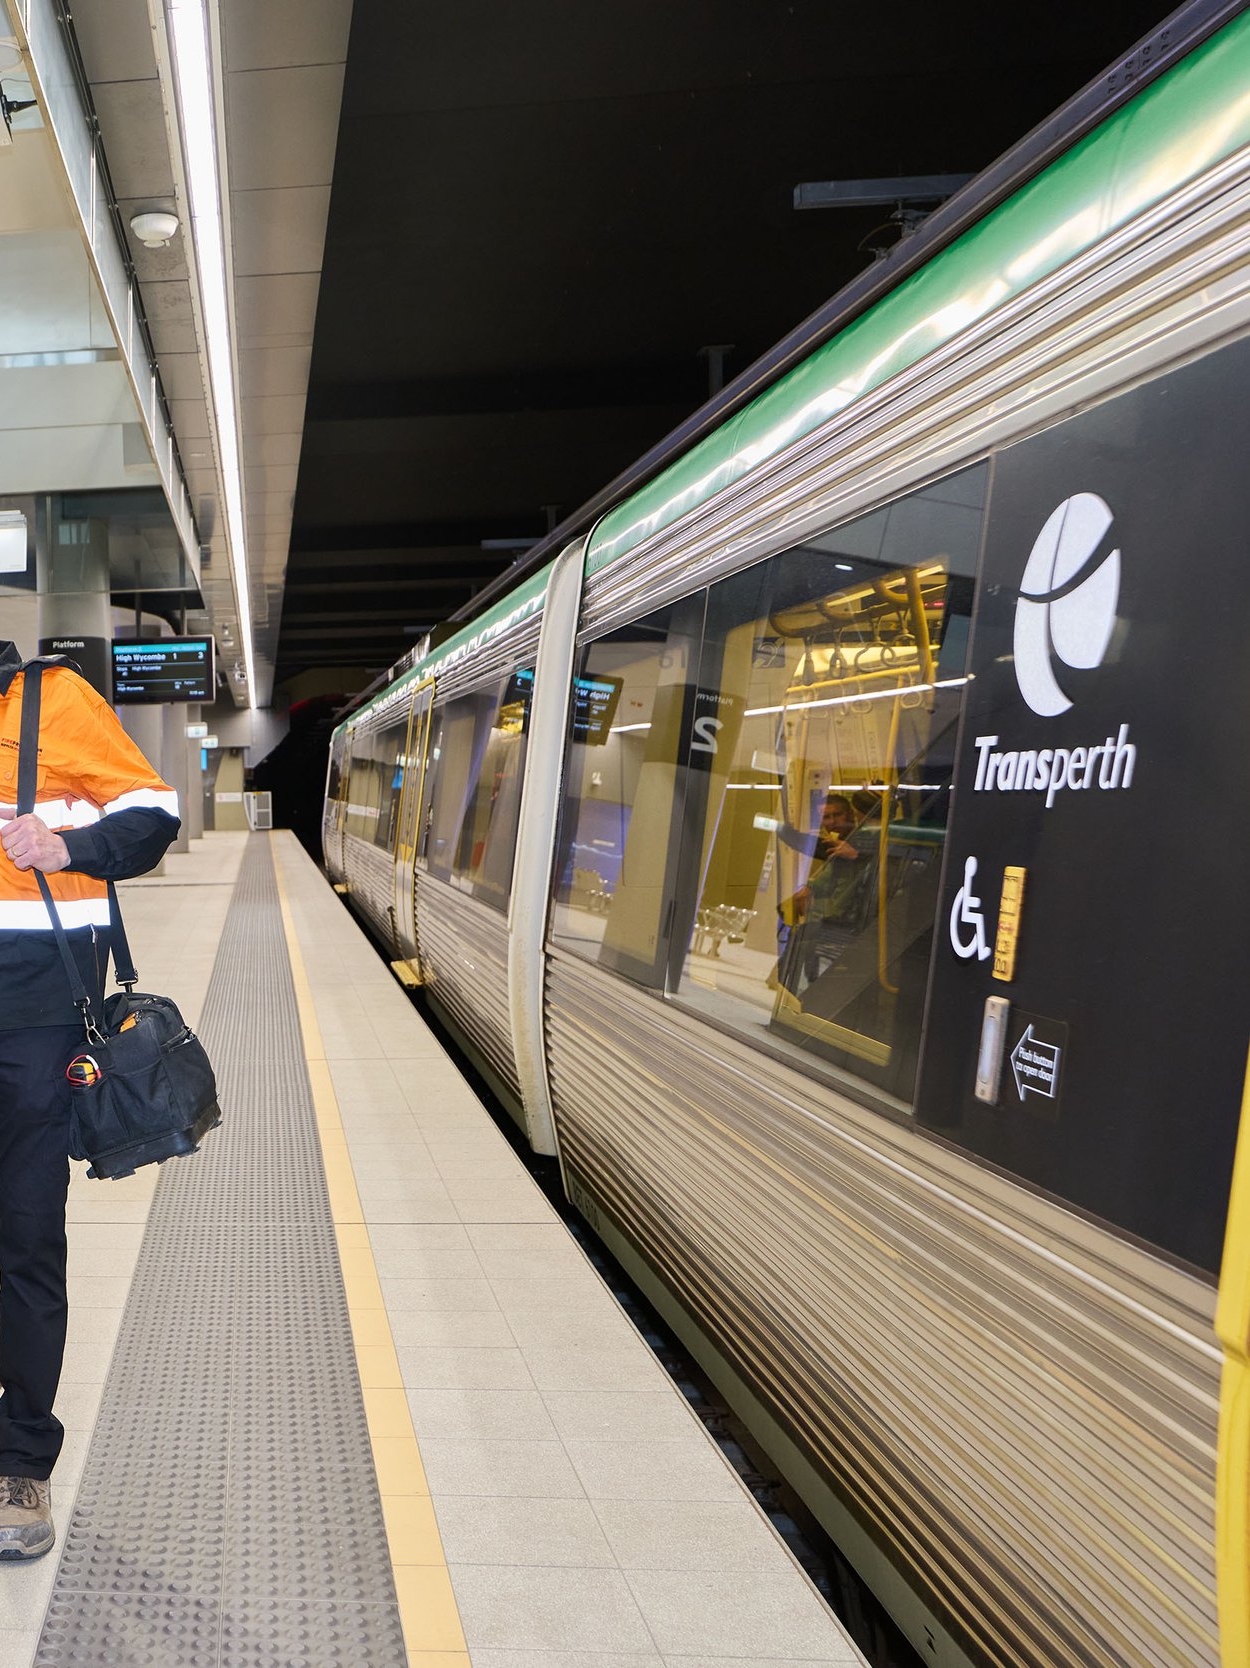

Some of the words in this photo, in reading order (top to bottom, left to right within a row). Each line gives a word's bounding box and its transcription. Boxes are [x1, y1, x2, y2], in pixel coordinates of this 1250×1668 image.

[52, 640, 85, 649] Platform
[116, 654, 133, 663] High
[133, 653, 166, 662] Wycombe
[172, 652, 178, 660] 1
[197, 651, 204, 659] 3
[974, 723, 1137, 808] Transperth
[1018, 1046, 1033, 1062] Push
[1032, 1051, 1054, 1069] button
[1022, 1064, 1038, 1077] open
[1037, 1067, 1055, 1082] door
